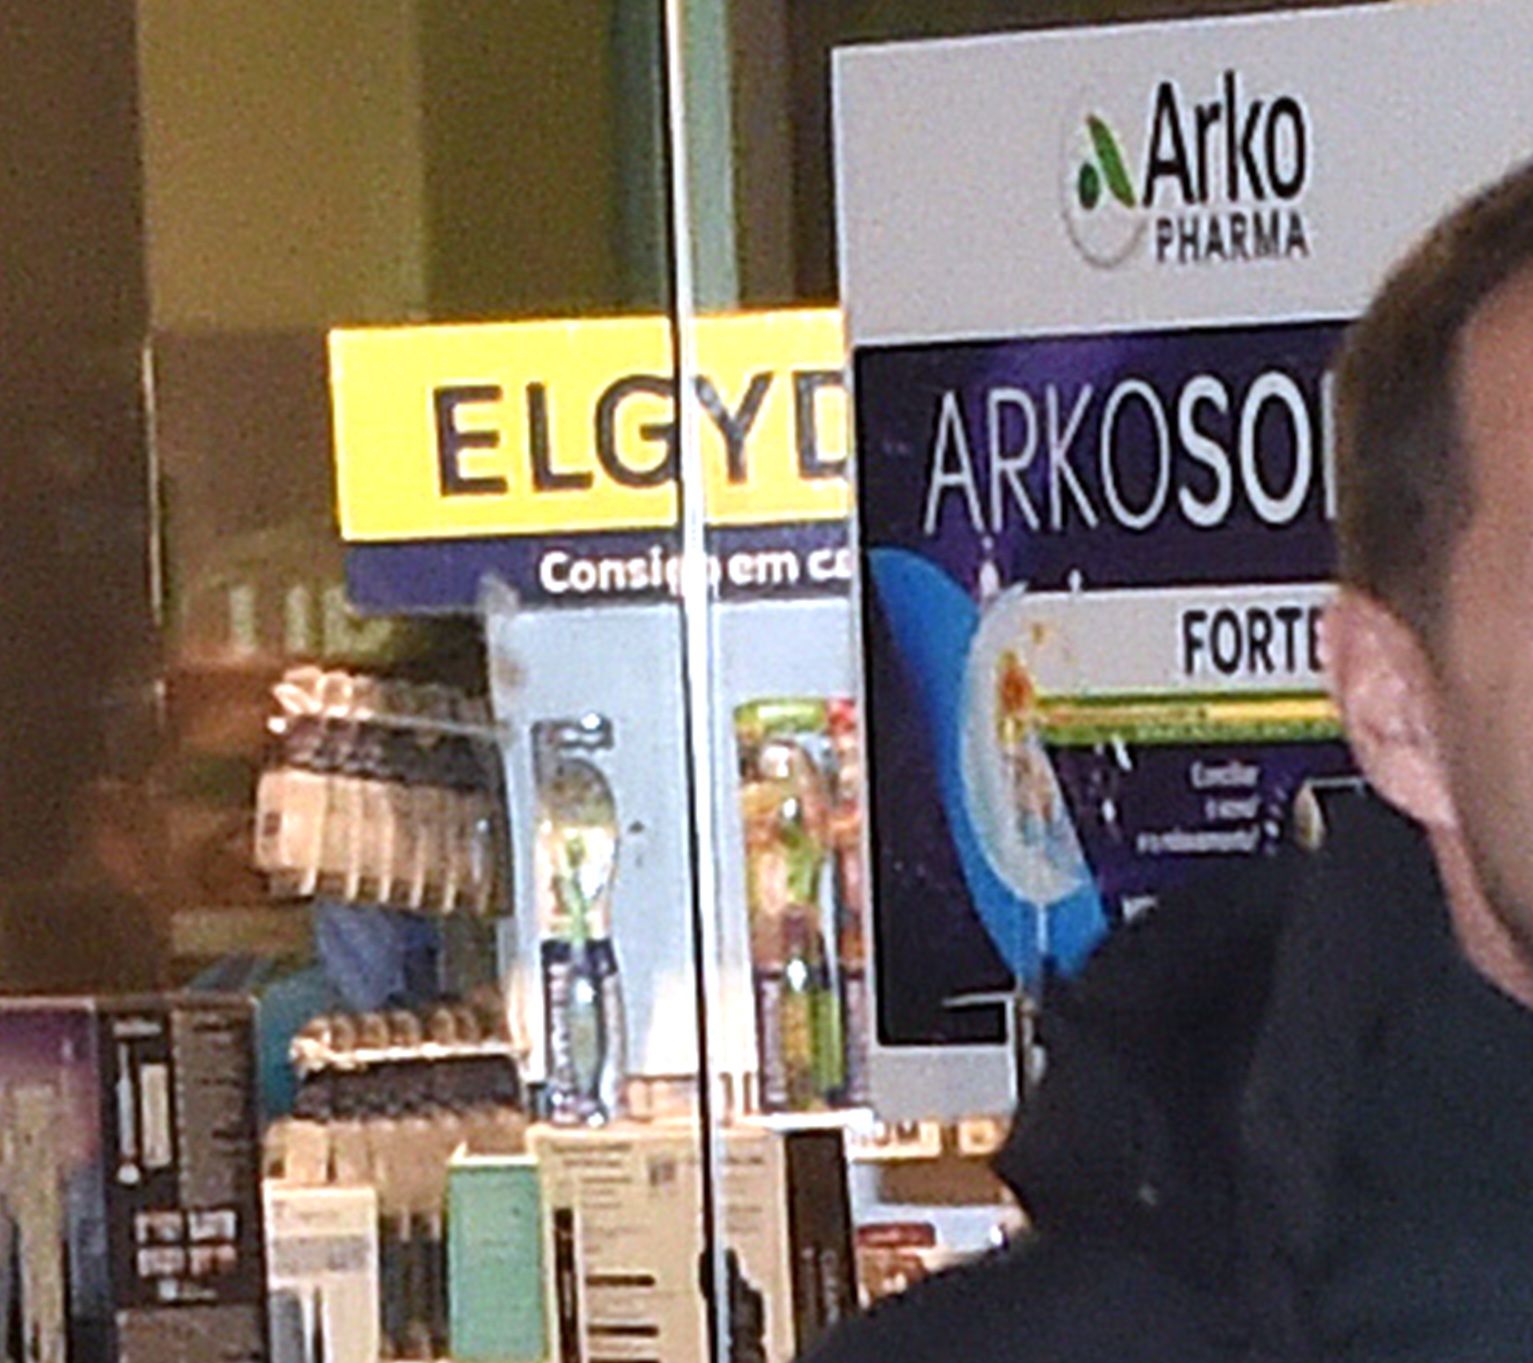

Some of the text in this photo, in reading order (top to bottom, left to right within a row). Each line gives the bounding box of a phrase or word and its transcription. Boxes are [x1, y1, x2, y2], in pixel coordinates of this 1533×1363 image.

[1142, 69, 1308, 207] Arko
[1156, 212, 1309, 264] PHARMA
[924, 369, 1338, 536] ARKOSO
[727, 550, 799, 586] em
